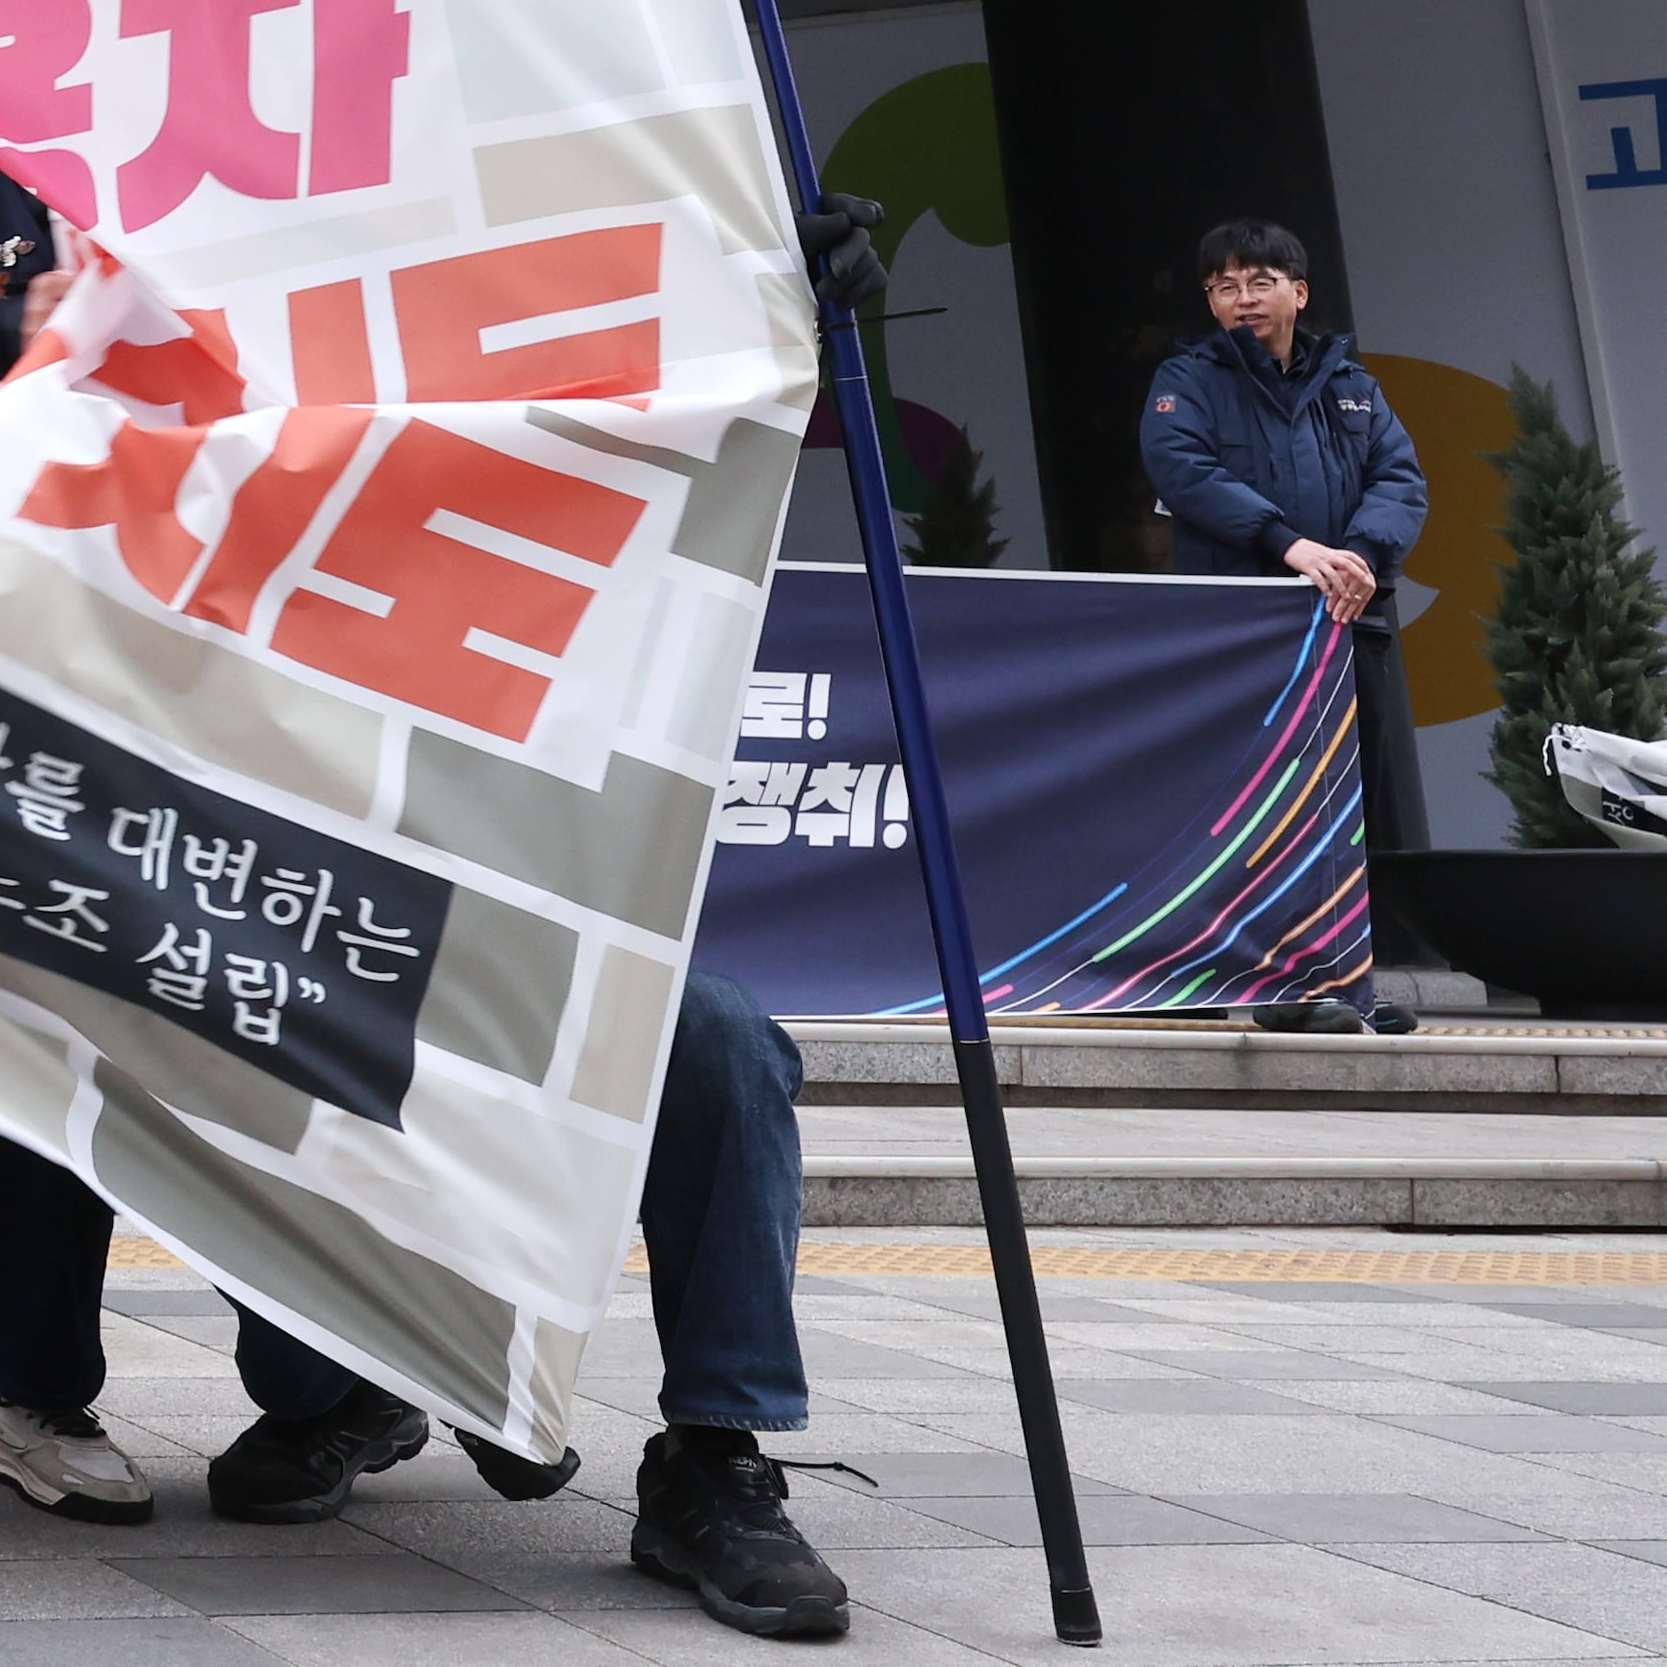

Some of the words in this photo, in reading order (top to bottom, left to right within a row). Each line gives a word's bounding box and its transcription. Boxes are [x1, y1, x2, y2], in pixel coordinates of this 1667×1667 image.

[716, 760, 910, 850] 쟁취!
[106, 806, 421, 982] 대변하는
[135, 921, 327, 1047] 설립”
